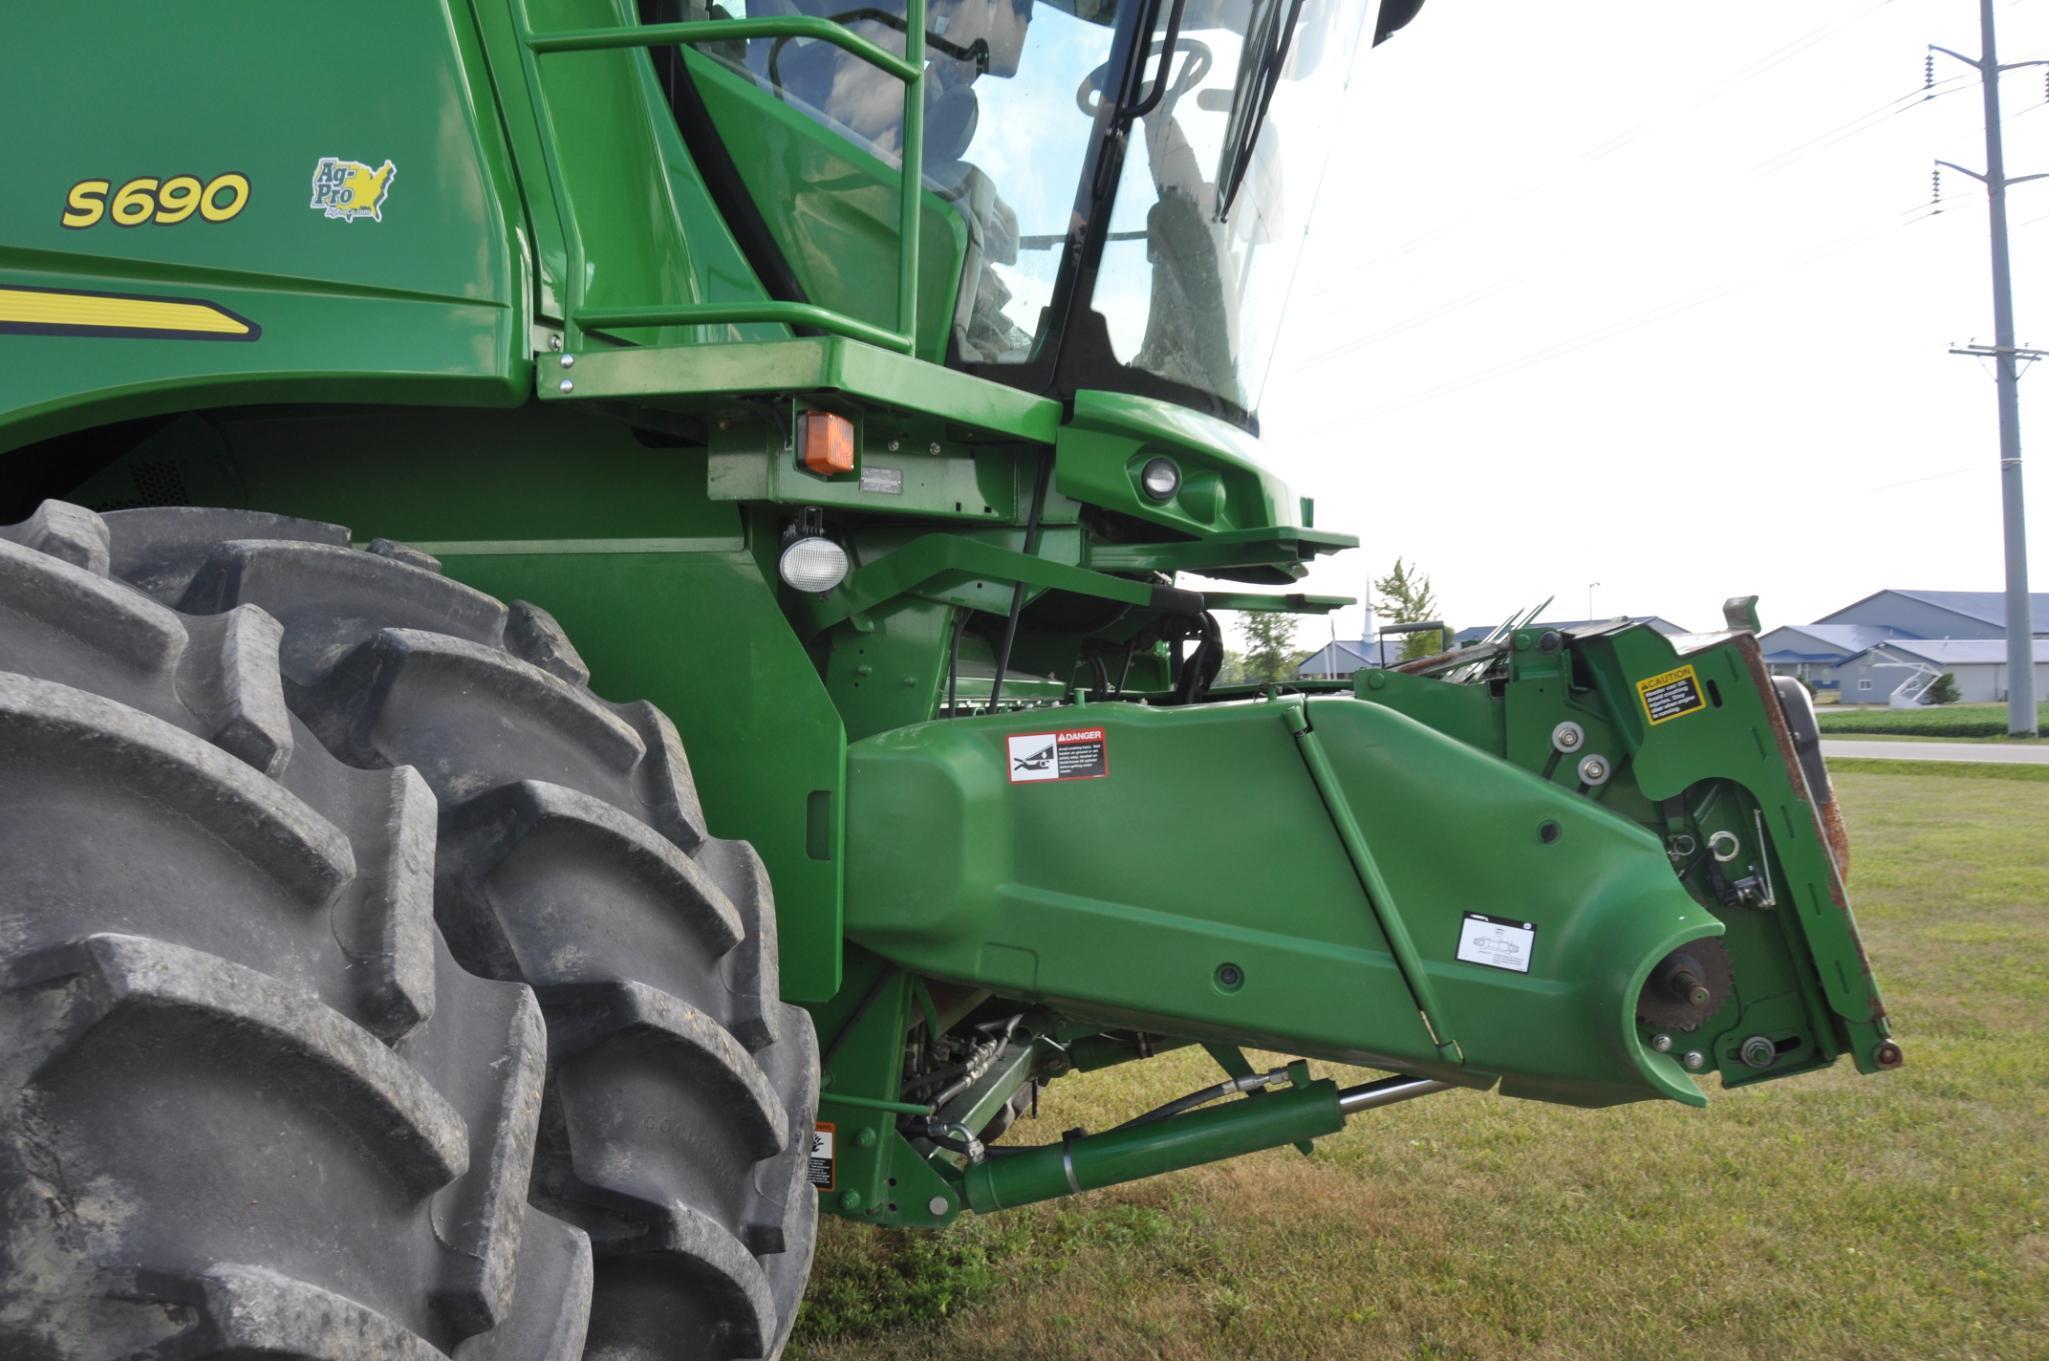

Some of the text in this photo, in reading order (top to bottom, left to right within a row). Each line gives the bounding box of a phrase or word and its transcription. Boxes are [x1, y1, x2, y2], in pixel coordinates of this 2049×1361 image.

[317, 162, 355, 186] Ag-
[61, 172, 250, 229] S690
[315, 184, 353, 204] Pro
[1647, 668, 1691, 688] CAUTION
[1065, 731, 1102, 741] DANGER
